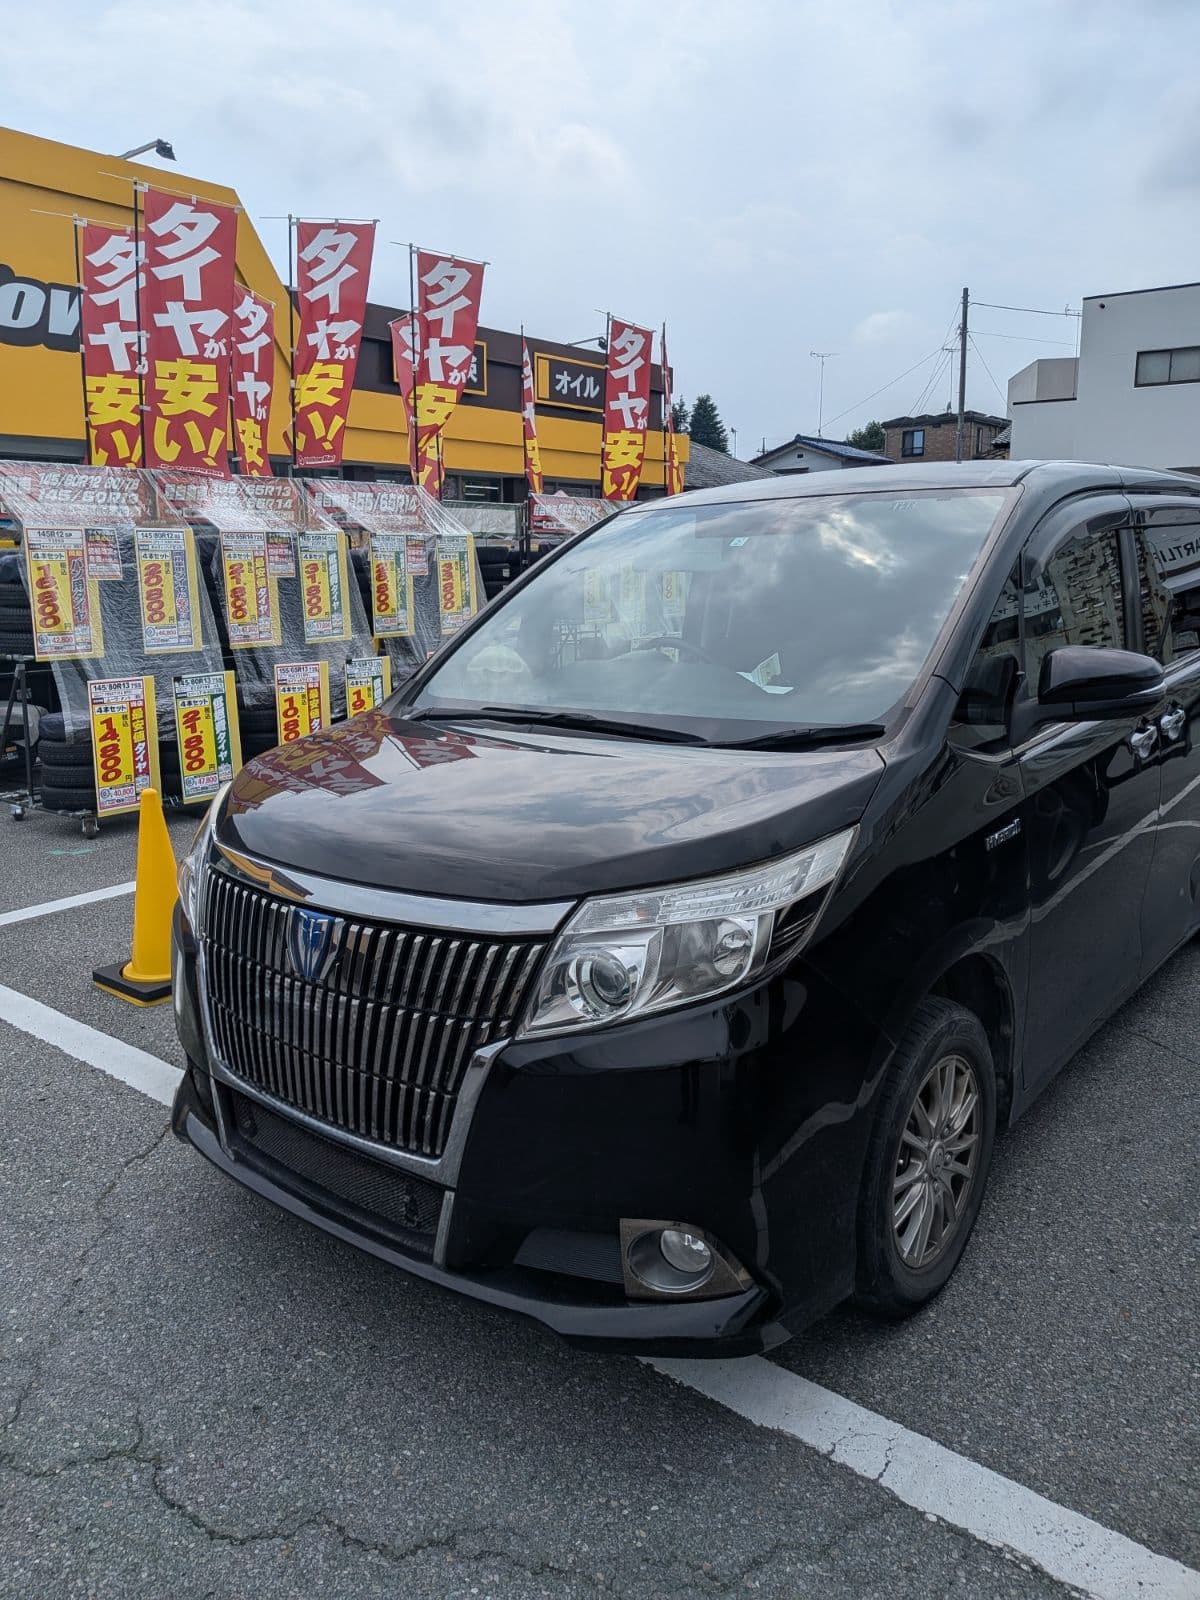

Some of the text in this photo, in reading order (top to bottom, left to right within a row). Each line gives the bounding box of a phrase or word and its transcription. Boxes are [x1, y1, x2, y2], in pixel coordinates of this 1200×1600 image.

[148, 202, 229, 463] タイヤが安い!
[234, 295, 271, 476] タイヤが安
[555, 371, 600, 399] オイル
[180, 698, 208, 707] 4本セット
[96, 704, 127, 714] 4本セット
[208, 763, 215, 771] 円
[125, 774, 132, 782] 円
